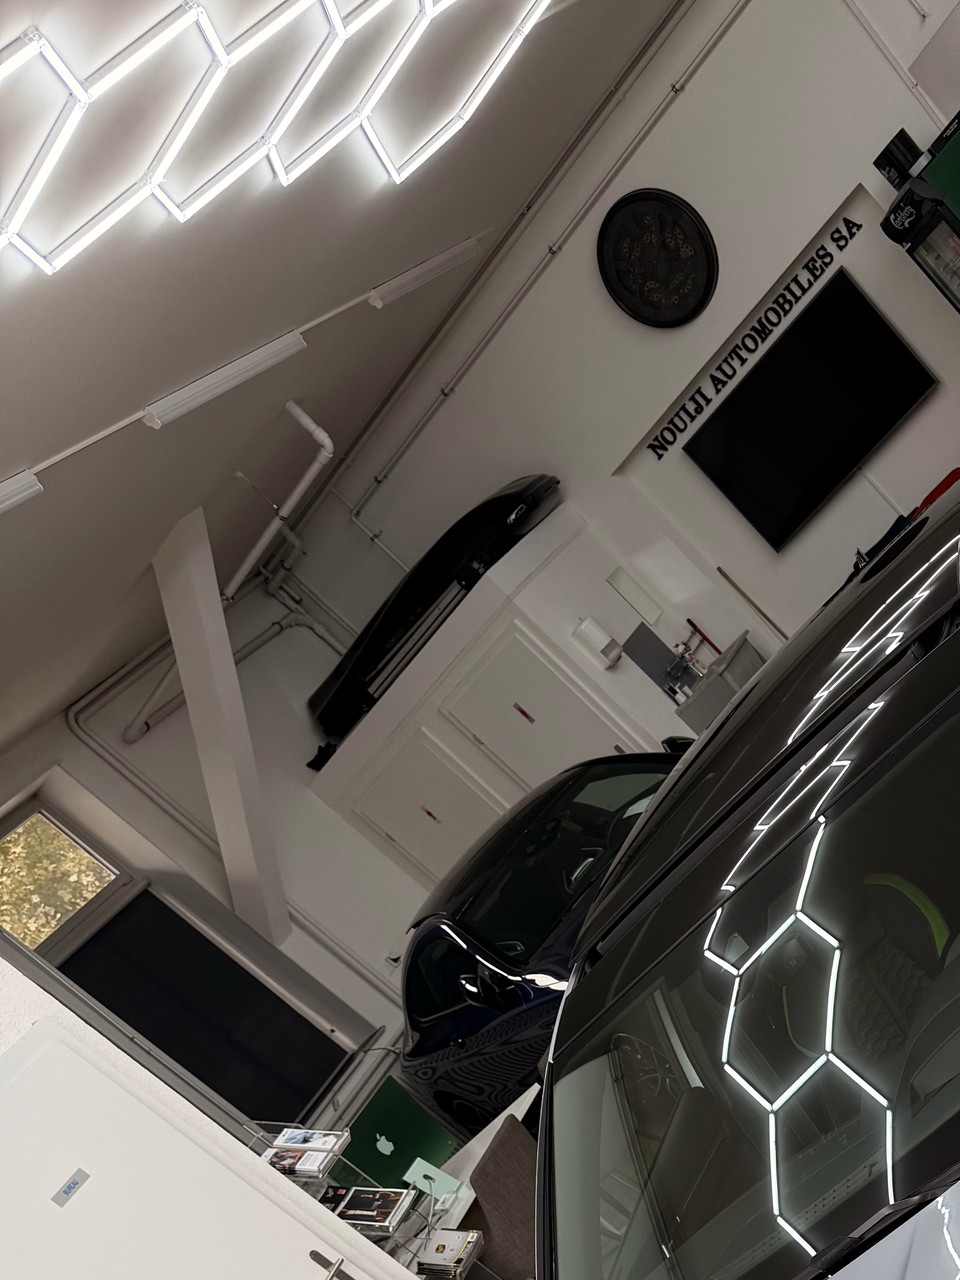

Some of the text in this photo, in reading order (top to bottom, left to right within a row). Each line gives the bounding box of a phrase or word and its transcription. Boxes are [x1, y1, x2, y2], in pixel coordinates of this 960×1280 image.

[889, 203, 917, 230] Carlsberg
[647, 216, 863, 460] NOUIJI AUTOMOBILES SA
